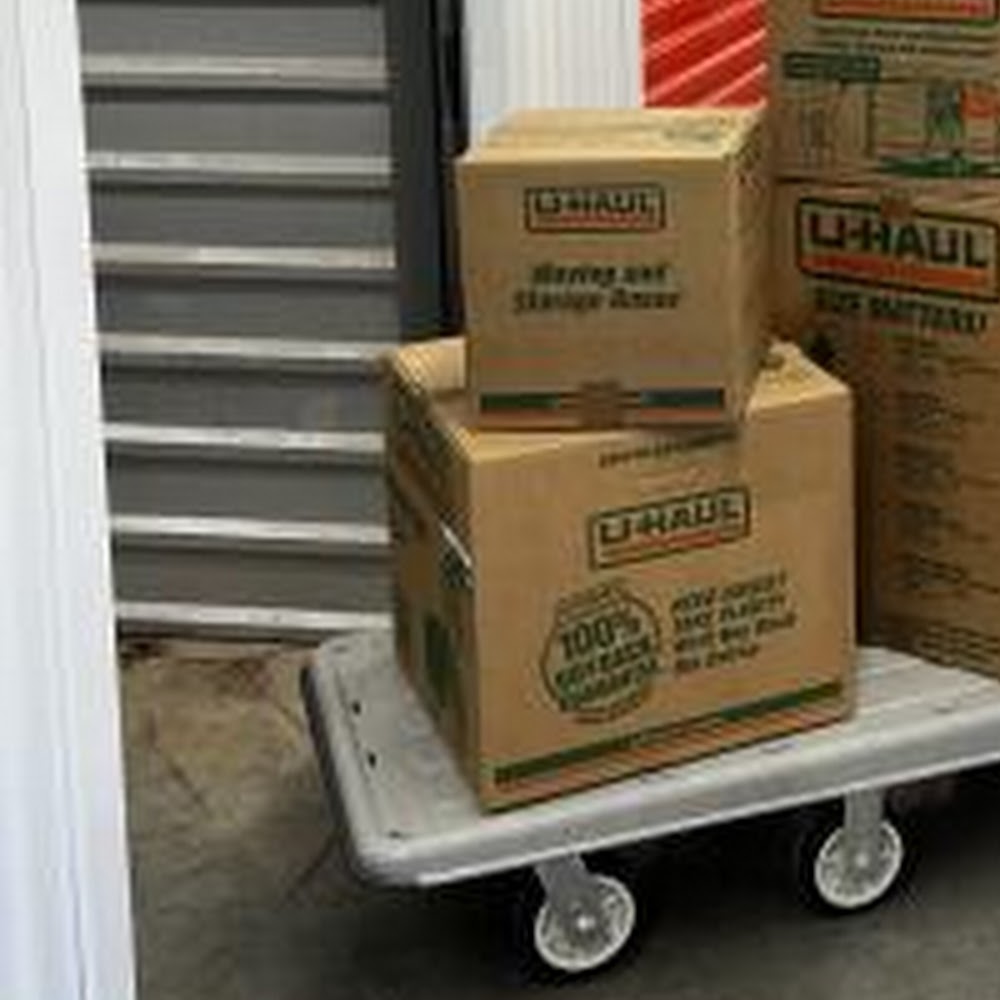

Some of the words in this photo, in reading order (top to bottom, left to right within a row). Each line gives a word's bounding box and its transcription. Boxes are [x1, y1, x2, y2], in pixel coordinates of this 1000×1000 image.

[533, 191, 651, 214] U-HAUL
[809, 212, 989, 268] U-HAUL
[600, 496, 741, 546] U-HAUL
[560, 605, 643, 660] 100%
